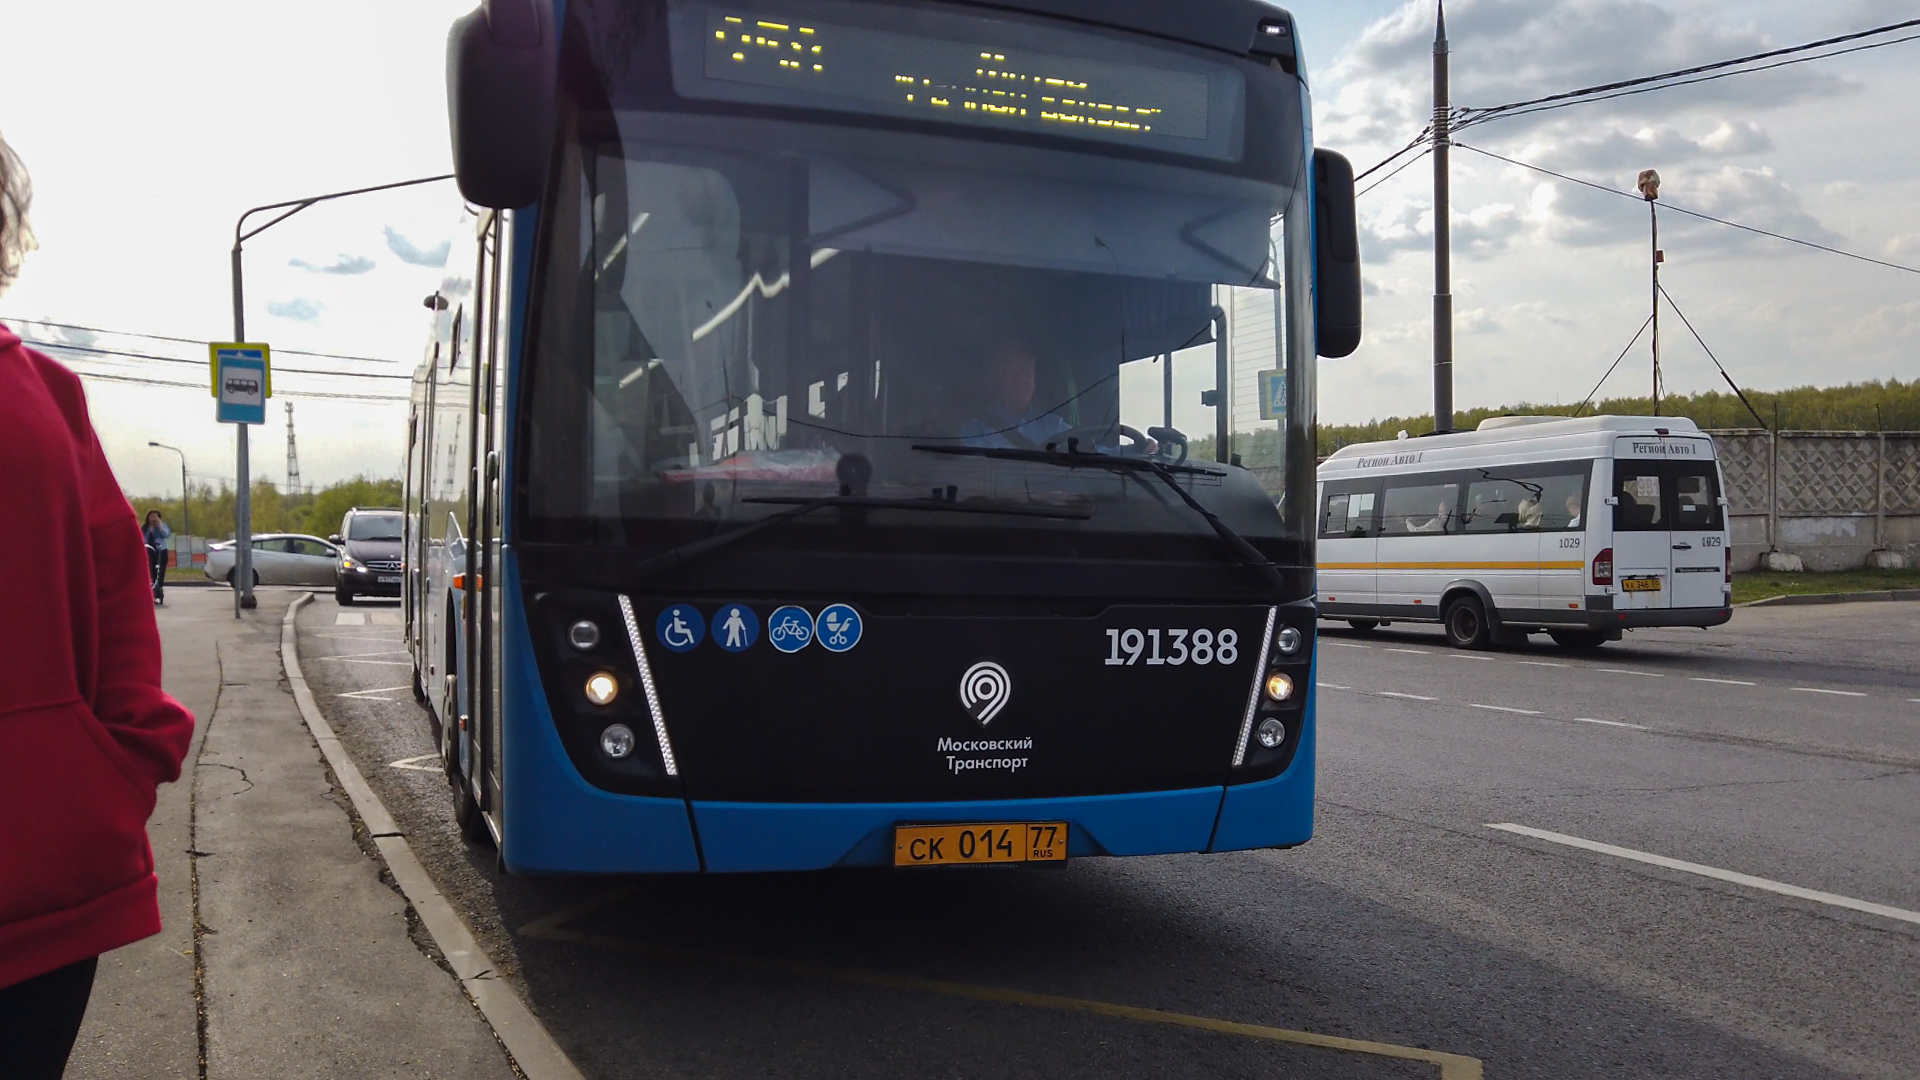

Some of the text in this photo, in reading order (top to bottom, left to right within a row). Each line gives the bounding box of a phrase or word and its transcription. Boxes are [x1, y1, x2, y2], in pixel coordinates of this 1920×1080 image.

[1632, 443, 1666, 454] Регион
[1668, 443, 1690, 454] Авто
[1357, 457, 1390, 468] Регион
[1391, 454, 1415, 465] Авто
[1559, 538, 1581, 549] 1029
[1702, 537, 1721, 547] 1029
[1104, 628, 1239, 667] 191388
[937, 736, 1033, 752] Московский
[946, 755, 1029, 775] Транспорт
[909, 827, 1057, 861] СК 014 77
[1032, 849, 1054, 859] RUS
